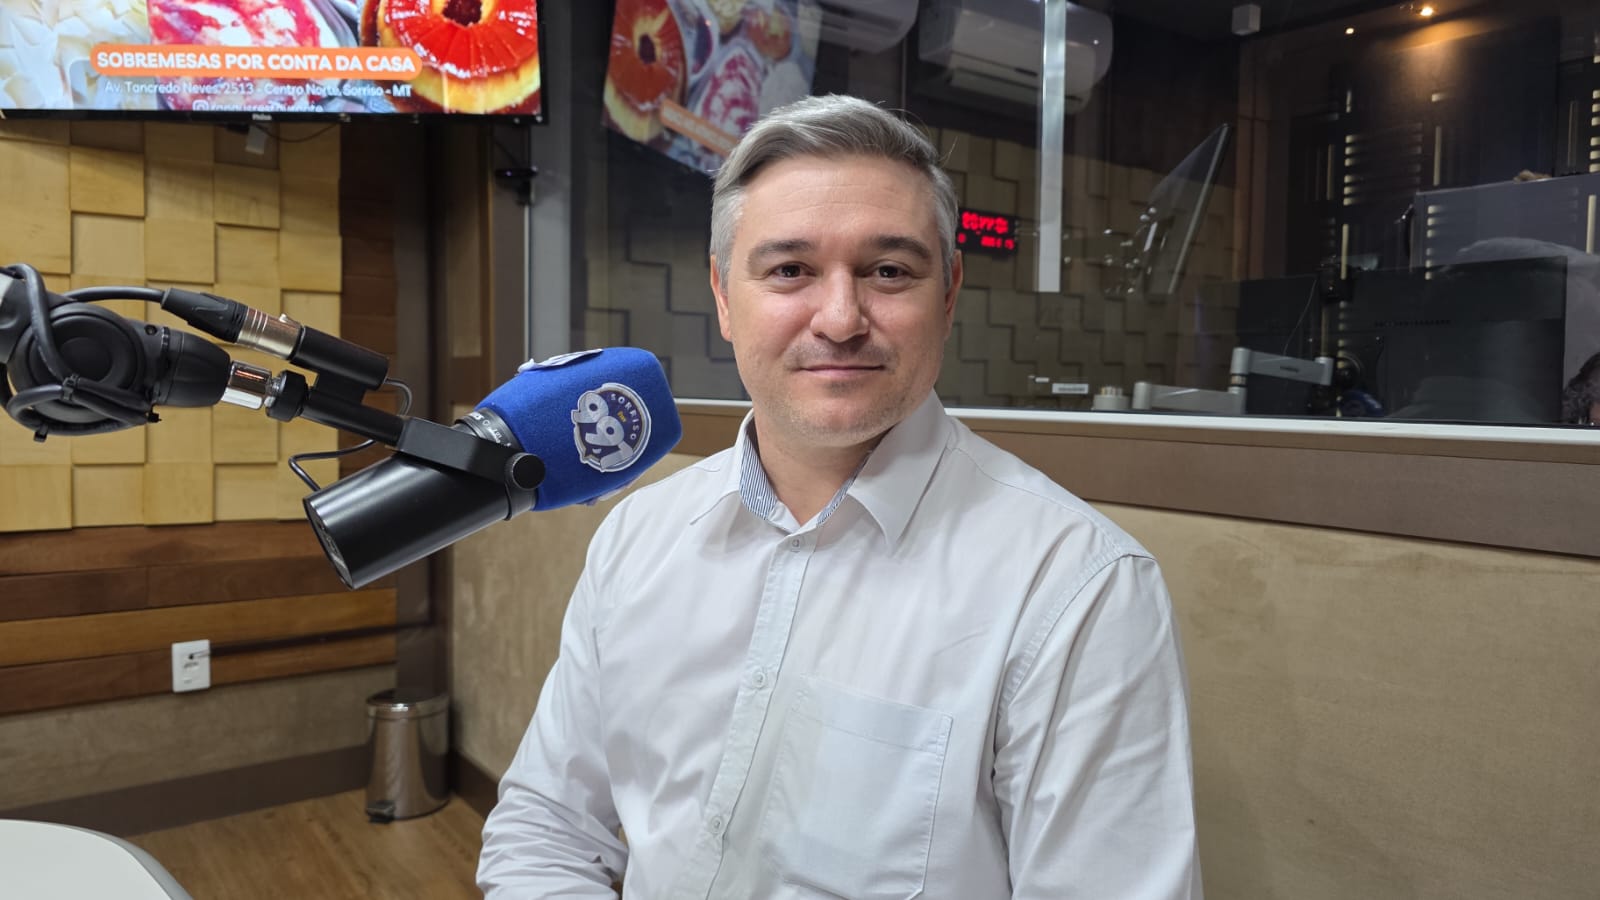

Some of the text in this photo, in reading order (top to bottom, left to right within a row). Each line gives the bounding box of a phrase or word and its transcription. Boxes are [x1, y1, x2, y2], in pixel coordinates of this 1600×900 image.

[97, 52, 415, 73] SOBREMESAS POR CONTA DA CASA
[125, 81, 179, 95] Tancredo
[223, 83, 254, 95] 2513
[264, 84, 305, 96] Centro
[343, 84, 383, 98] Sorriso
[392, 84, 411, 97] MT
[610, 393, 640, 440] SORRISO
